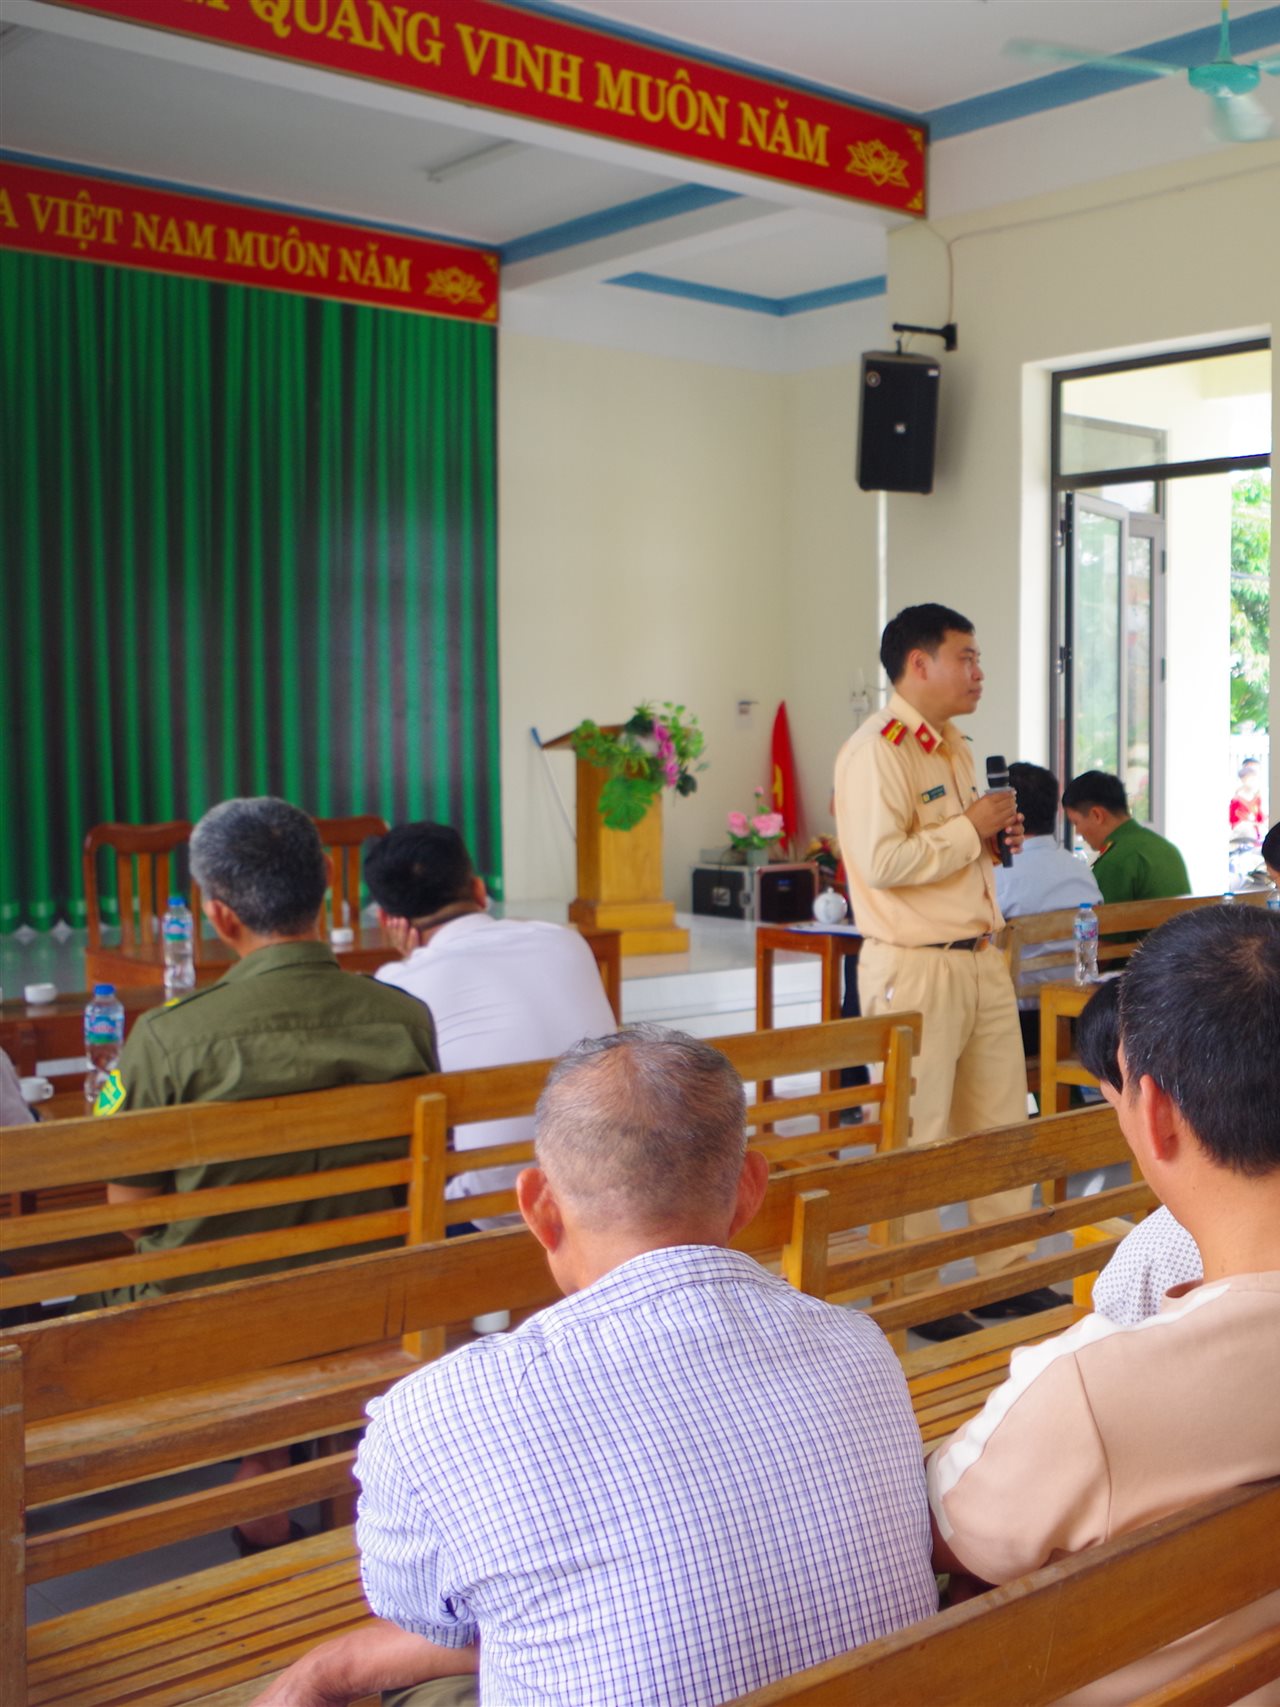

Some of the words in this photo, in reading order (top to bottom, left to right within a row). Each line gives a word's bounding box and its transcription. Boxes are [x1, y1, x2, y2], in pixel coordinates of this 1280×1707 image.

[249, 0, 445, 66] QUANG
[455, 22, 583, 103] VINH
[594, 68, 728, 139] MUÔN
[739, 100, 829, 167] NĂM
[27, 189, 123, 250] VIỆT
[131, 211, 216, 260] NAM
[225, 225, 330, 276] MUÔN
[338, 248, 412, 292] NĂM
